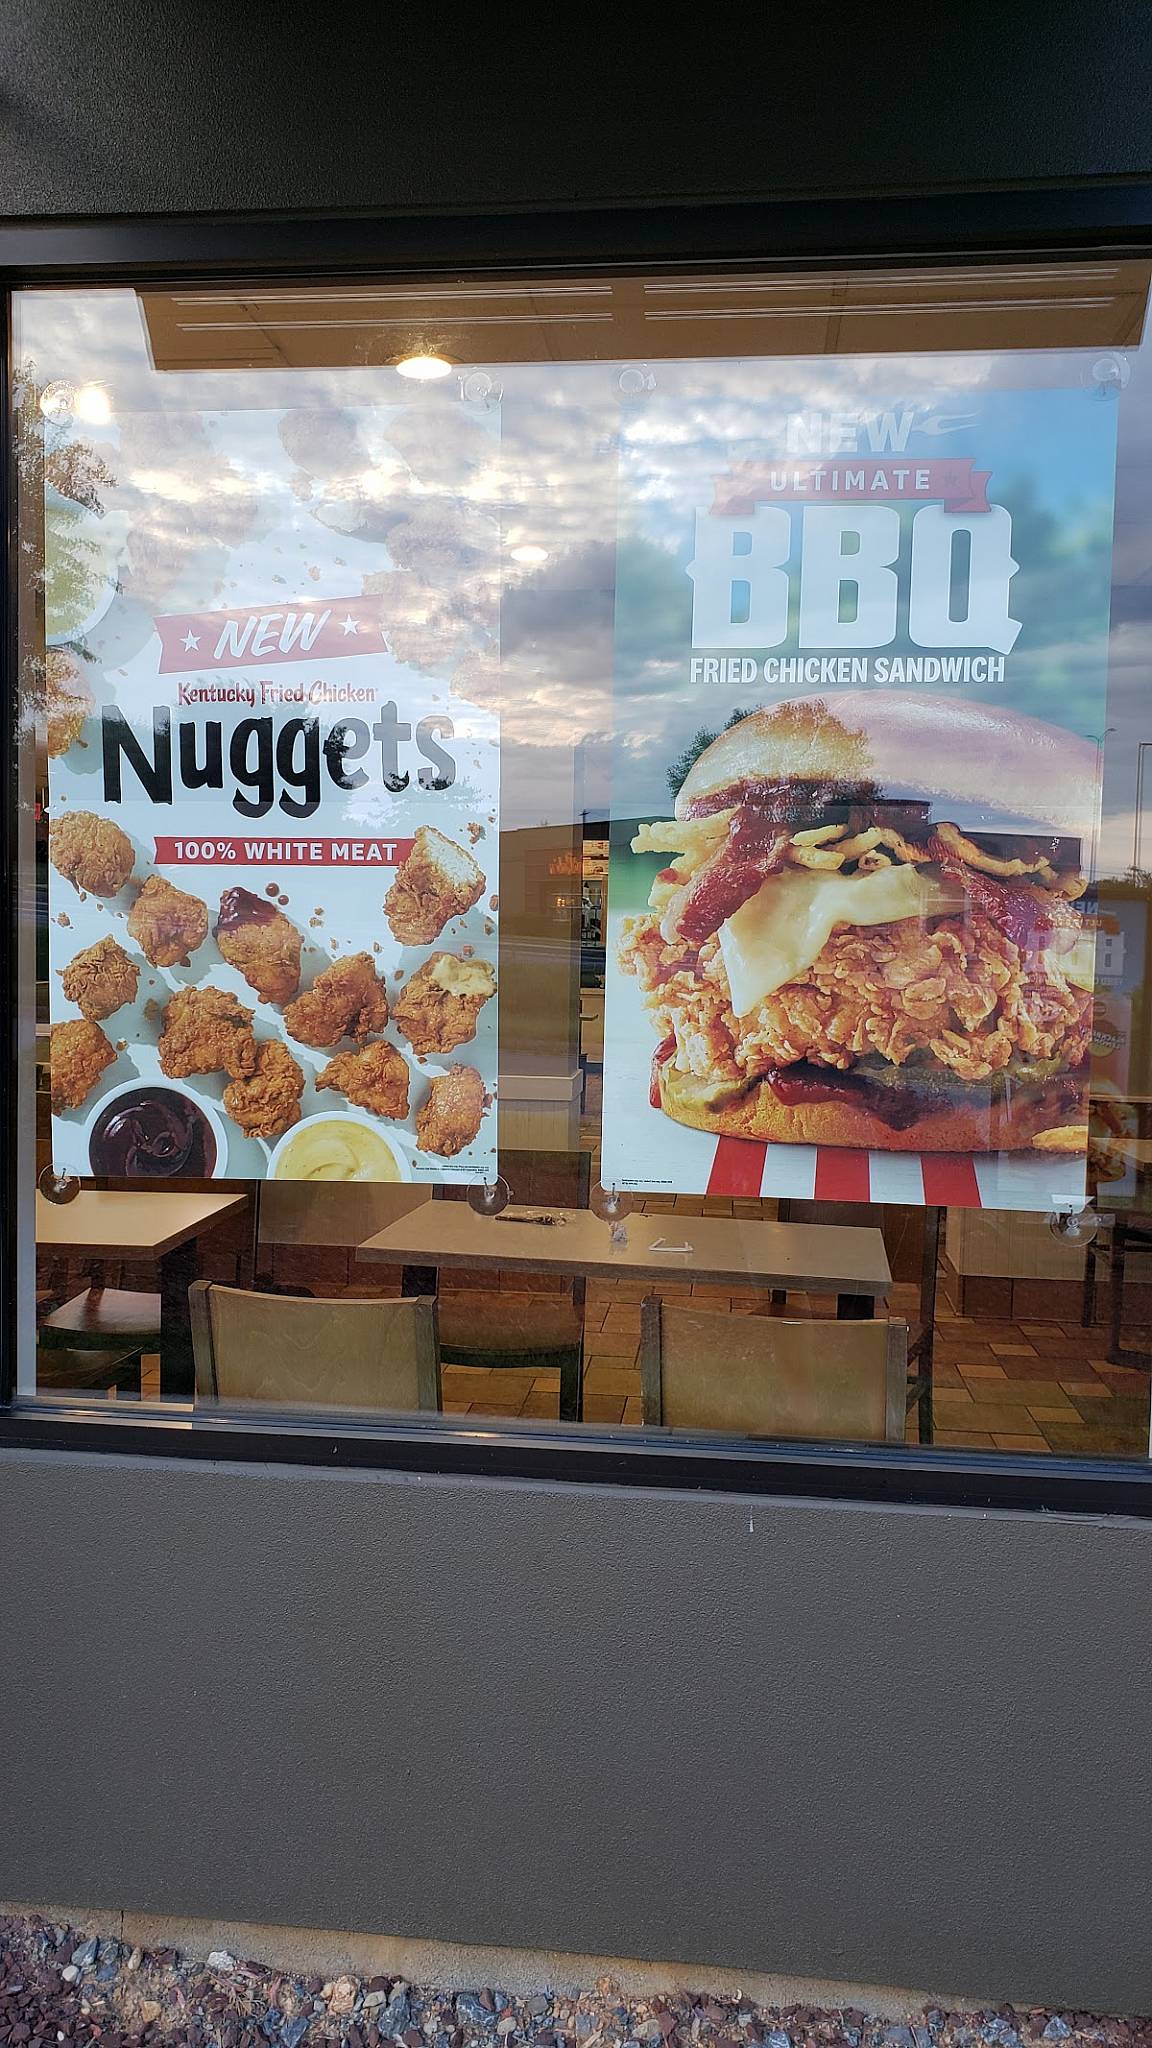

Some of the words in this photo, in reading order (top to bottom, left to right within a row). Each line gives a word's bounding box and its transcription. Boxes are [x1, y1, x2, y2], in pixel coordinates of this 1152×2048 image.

[786, 411, 914, 452] NEW
[770, 469, 930, 491] ULTIMATE
[685, 504, 1023, 655] BBQ
[213, 609, 331, 660] NEW
[689, 658, 758, 683] FRIED
[763, 657, 868, 683] CHICKEN
[872, 656, 1005, 683] SANDWICH
[178, 681, 255, 707] Kentucky
[259, 680, 304, 705] Fried
[308, 680, 375, 705] Chicken
[101, 700, 456, 818] Nuggets
[173, 841, 237, 860] 100%
[244, 842, 323, 861] WHITE
[331, 842, 398, 862] MEAT
